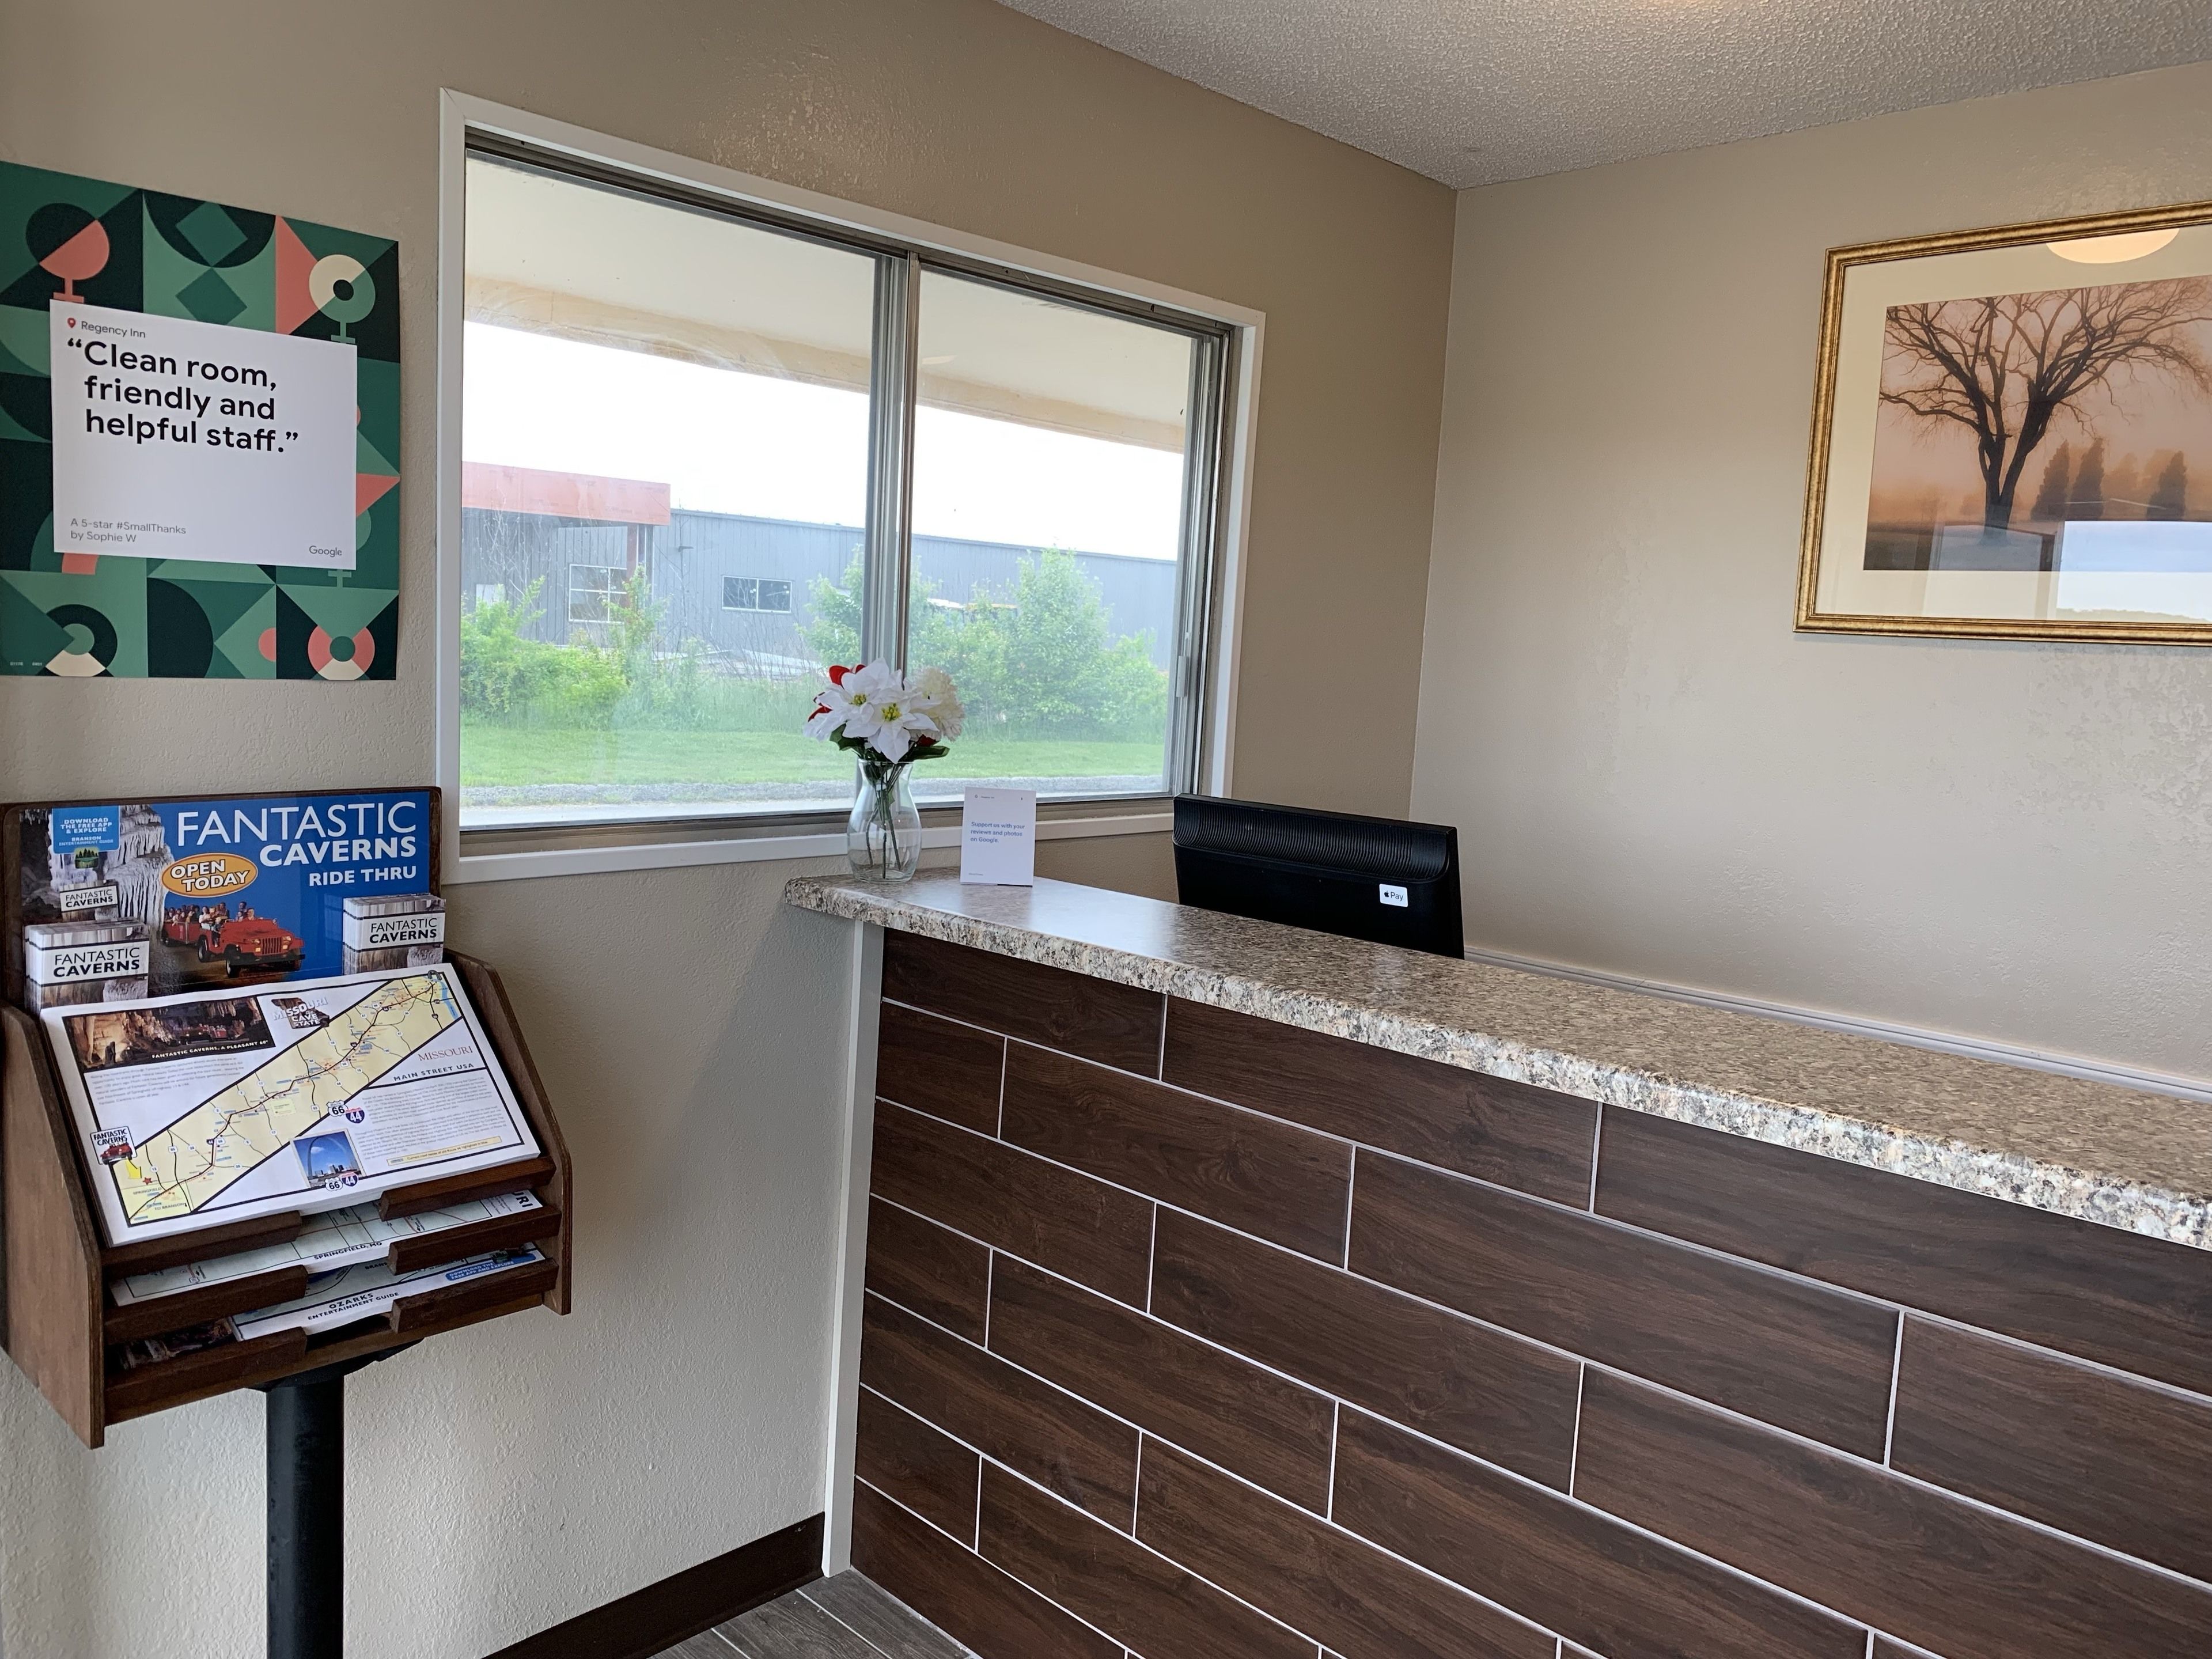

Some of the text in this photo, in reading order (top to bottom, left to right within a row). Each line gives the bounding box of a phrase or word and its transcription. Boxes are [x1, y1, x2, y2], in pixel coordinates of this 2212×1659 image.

[81, 321, 146, 339] Regency Inn
[67, 338, 276, 391] “Clean room,
[84, 376, 275, 420] friendly and
[86, 409, 298, 453] helpful staff.”
[70, 518, 187, 534] A 5-star #SmallThanks
[70, 531, 137, 542] by Sophie W
[309, 545, 343, 558] Google
[177, 801, 416, 847] FANTASTIC
[259, 836, 416, 867] CAVERNS
[171, 859, 225, 879] OPEN
[309, 865, 416, 887] RIDE THRU
[181, 870, 250, 892] TODAY
[65, 889, 112, 902] FANTASTIC
[66, 896, 113, 908] CAVERNS
[1390, 891, 1404, 902] Pay
[370, 918, 437, 933] FANTASTIC
[369, 929, 437, 944] CAVERNS
[55, 947, 140, 965] FANTASTIC
[53, 959, 140, 978] CAVERNS
[291, 1013, 318, 1021] CAVE
[294, 1019, 320, 1027] STATE
[151, 1049, 188, 1059] FANTASTIC
[227, 1041, 258, 1050] PLEASANT
[418, 1046, 474, 1061] MISSOURI
[393, 1073, 418, 1081] MAIN
[421, 1066, 453, 1075] STREET
[332, 1105, 345, 1115] 66
[350, 1111, 362, 1122] 44
[93, 1128, 127, 1141] FANTASTIC
[97, 1135, 128, 1146] CAVERNS
[329, 1181, 340, 1190] 66
[346, 1176, 356, 1185] 44
[314, 1244, 369, 1260] SPRINGFIELD,
[449, 1265, 483, 1277] DOWNLOAD
[490, 1260, 515, 1269] EXPLORE
[308, 1292, 399, 1320] ENTERTAINMENT GUIDE
[329, 1293, 374, 1309] OZARKS
